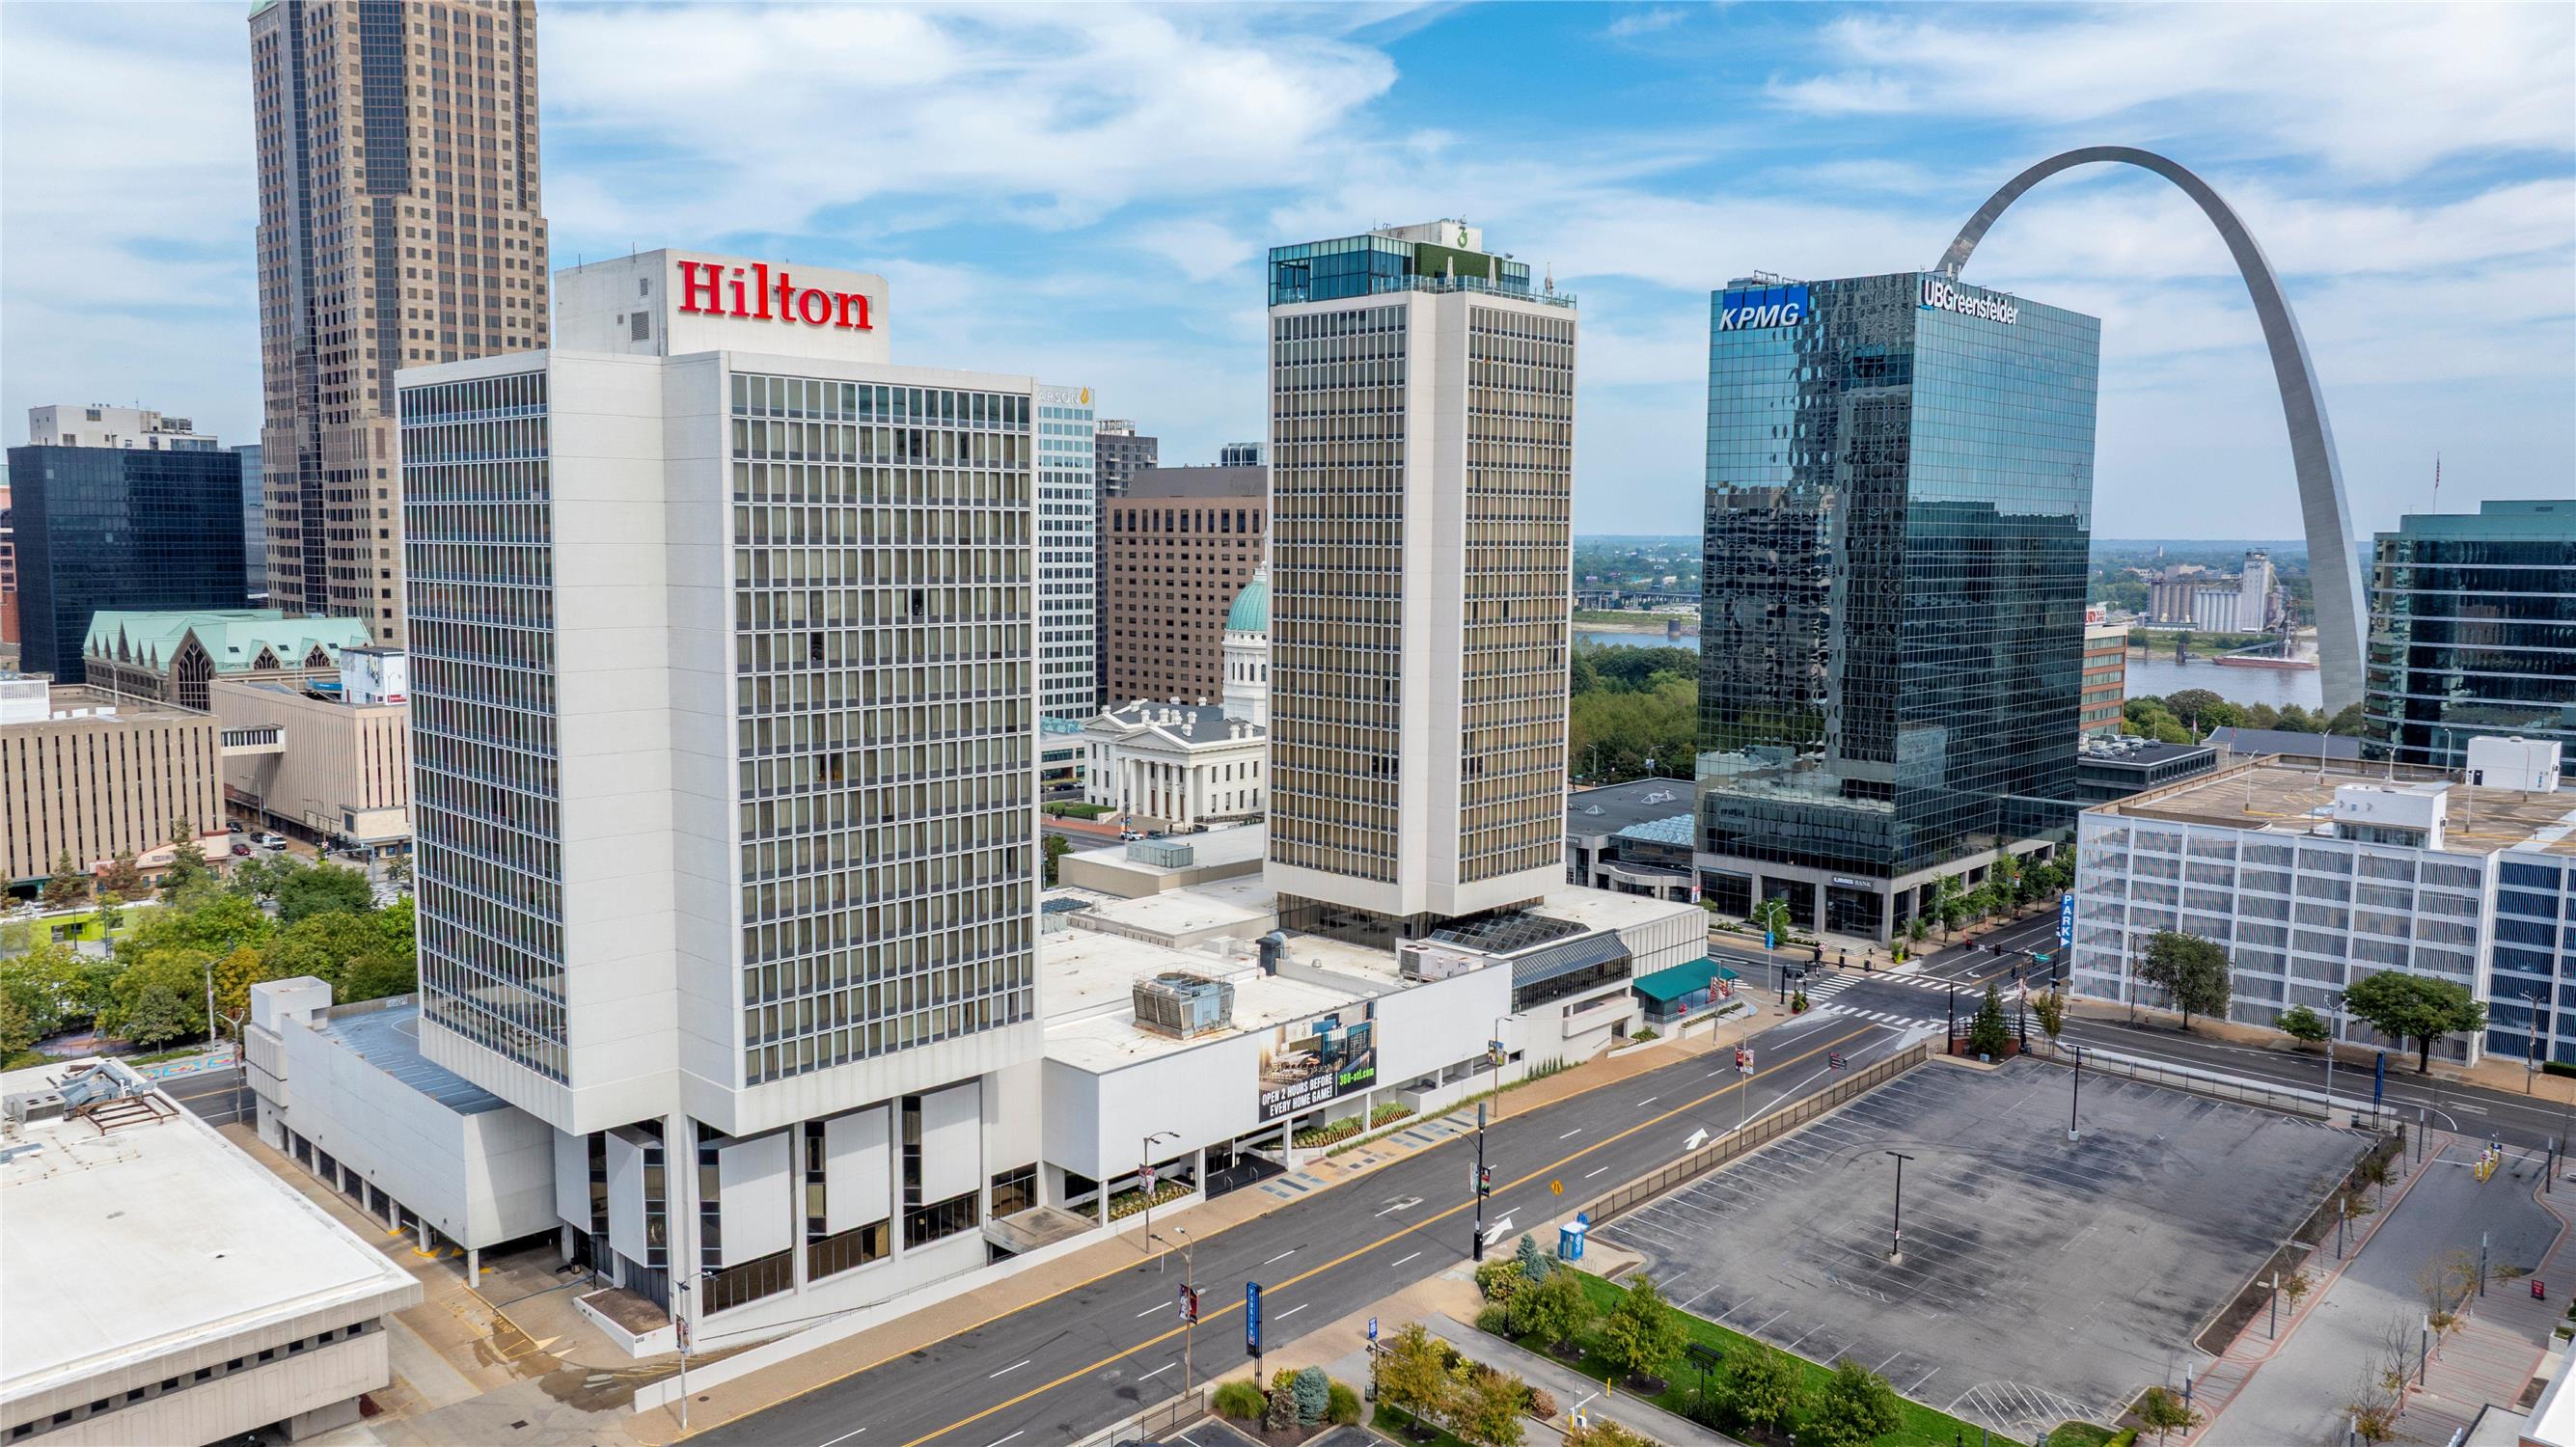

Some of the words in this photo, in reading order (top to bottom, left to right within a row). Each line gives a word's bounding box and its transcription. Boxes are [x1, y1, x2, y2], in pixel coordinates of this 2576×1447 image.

[677, 259, 873, 330] Hilton
[1924, 279, 2018, 325] UBGreensfelder
[1719, 302, 1799, 330] KPMG
[2061, 894, 2072, 937] PARK
[1262, 1089, 1279, 1106] OPEN
[1280, 1087, 1286, 1100] 2
[1287, 1080, 1308, 1098] HOURS
[1309, 1073, 1333, 1090] BEFORE
[1339, 1067, 1375, 1086] 360-stl.com
[1270, 1098, 1291, 1117] EVERY
[1292, 1093, 1311, 1111] HOME
[1312, 1084, 1333, 1104] GAME!
